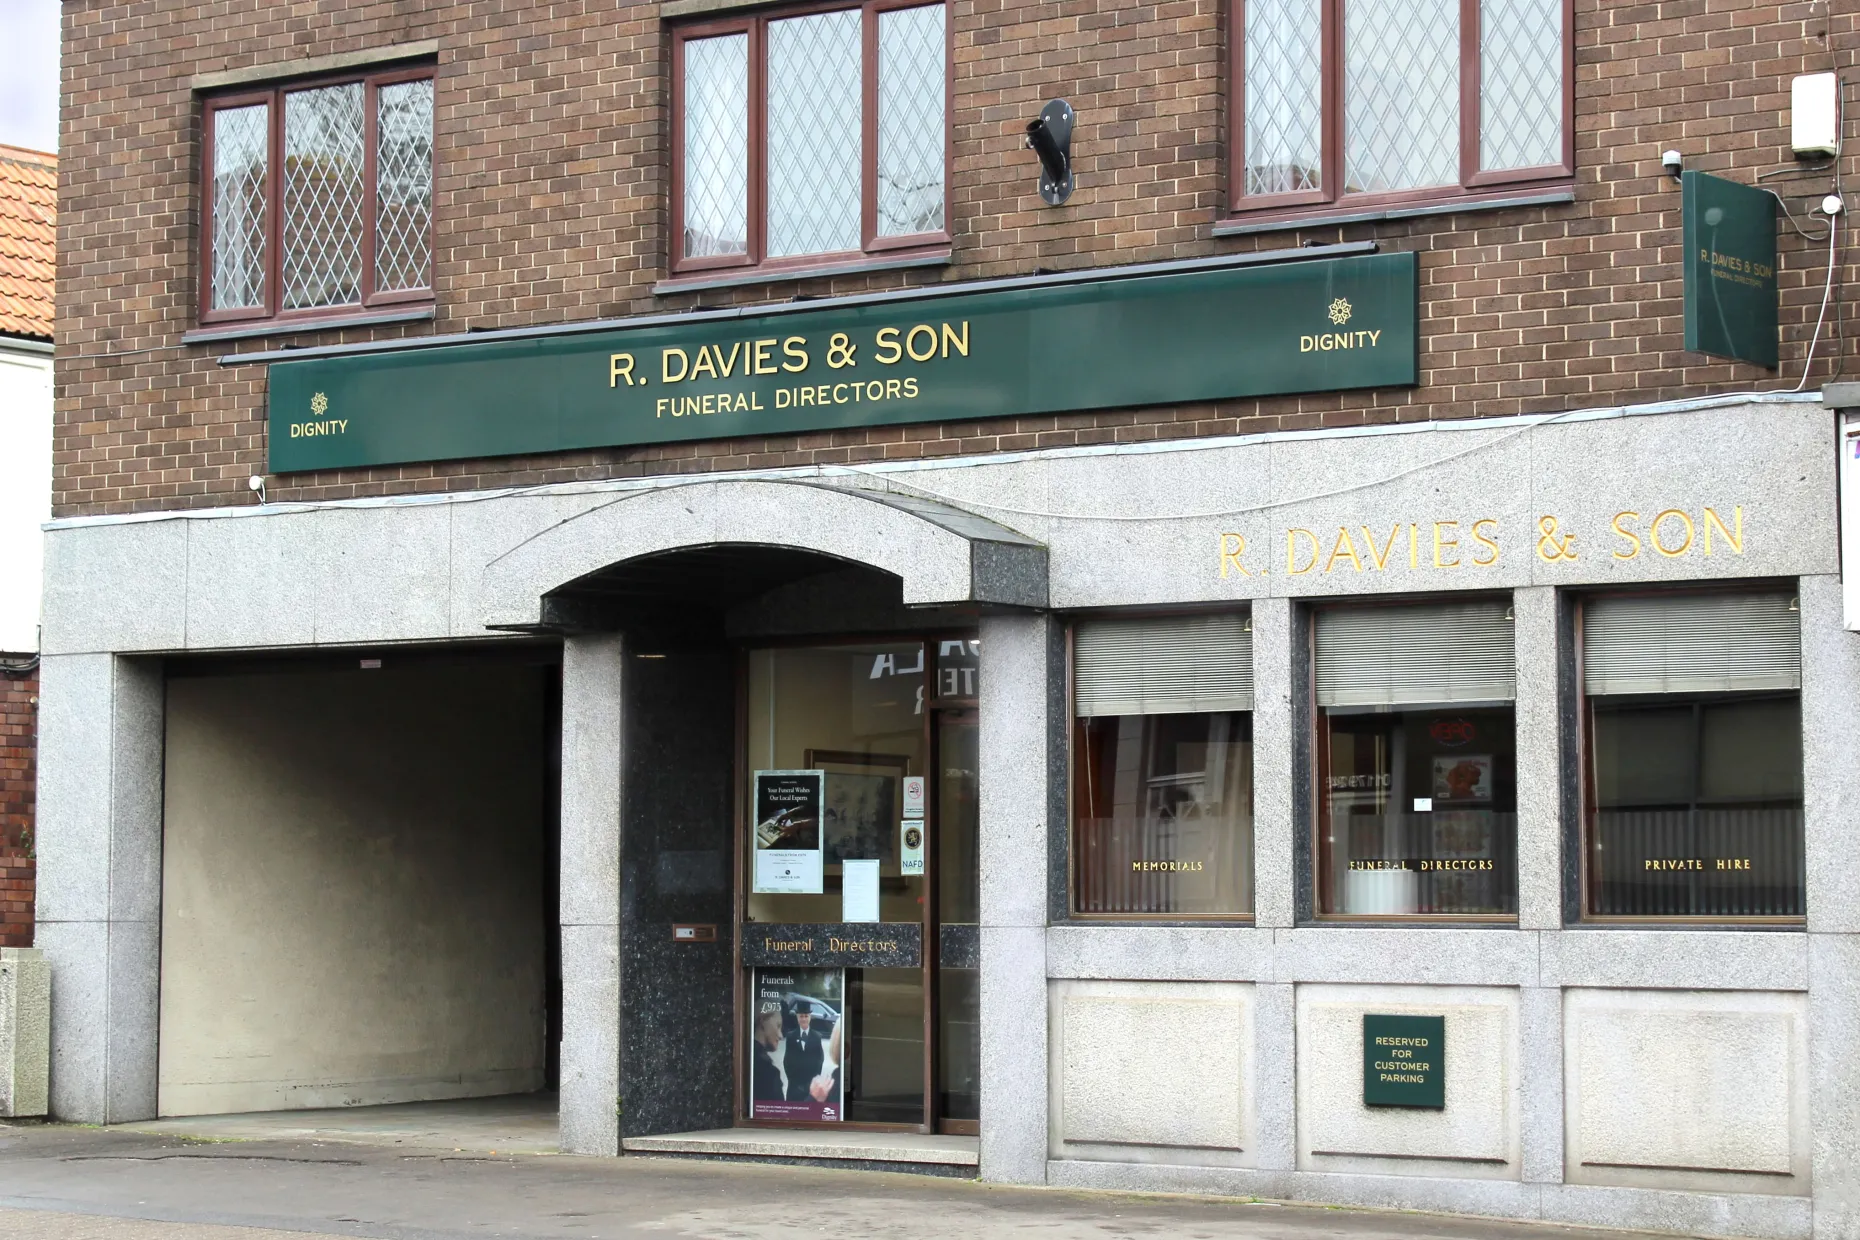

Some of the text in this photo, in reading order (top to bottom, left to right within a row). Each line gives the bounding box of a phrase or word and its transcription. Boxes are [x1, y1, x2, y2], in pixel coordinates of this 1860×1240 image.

[1700, 249, 1773, 278] R. DAVIES & SON
[1300, 329, 1382, 353] DIGNITY
[610, 321, 970, 388] R. DAVIES & SON
[656, 377, 919, 418] FUNERAL DIRECTORS
[290, 419, 349, 438] DIGNITY
[1219, 504, 1744, 579] R. DAVIES & SON
[902, 860, 923, 868] NAFD
[1132, 861, 1203, 872] MEMORIALS
[1349, 860, 1494, 871] FUNERAL DIRECTORS
[1645, 859, 1751, 870] PRIVATE HIRE
[765, 937, 897, 952] Funeral Directors
[761, 974, 795, 985] Funerals
[761, 988, 780, 998] from
[760, 1002, 782, 1014] £975
[1375, 1036, 1429, 1047] RESERVED
[1391, 1049, 1412, 1058] FOR
[1374, 1061, 1430, 1071] CUSTOMER
[1380, 1073, 1425, 1083] PARKING
